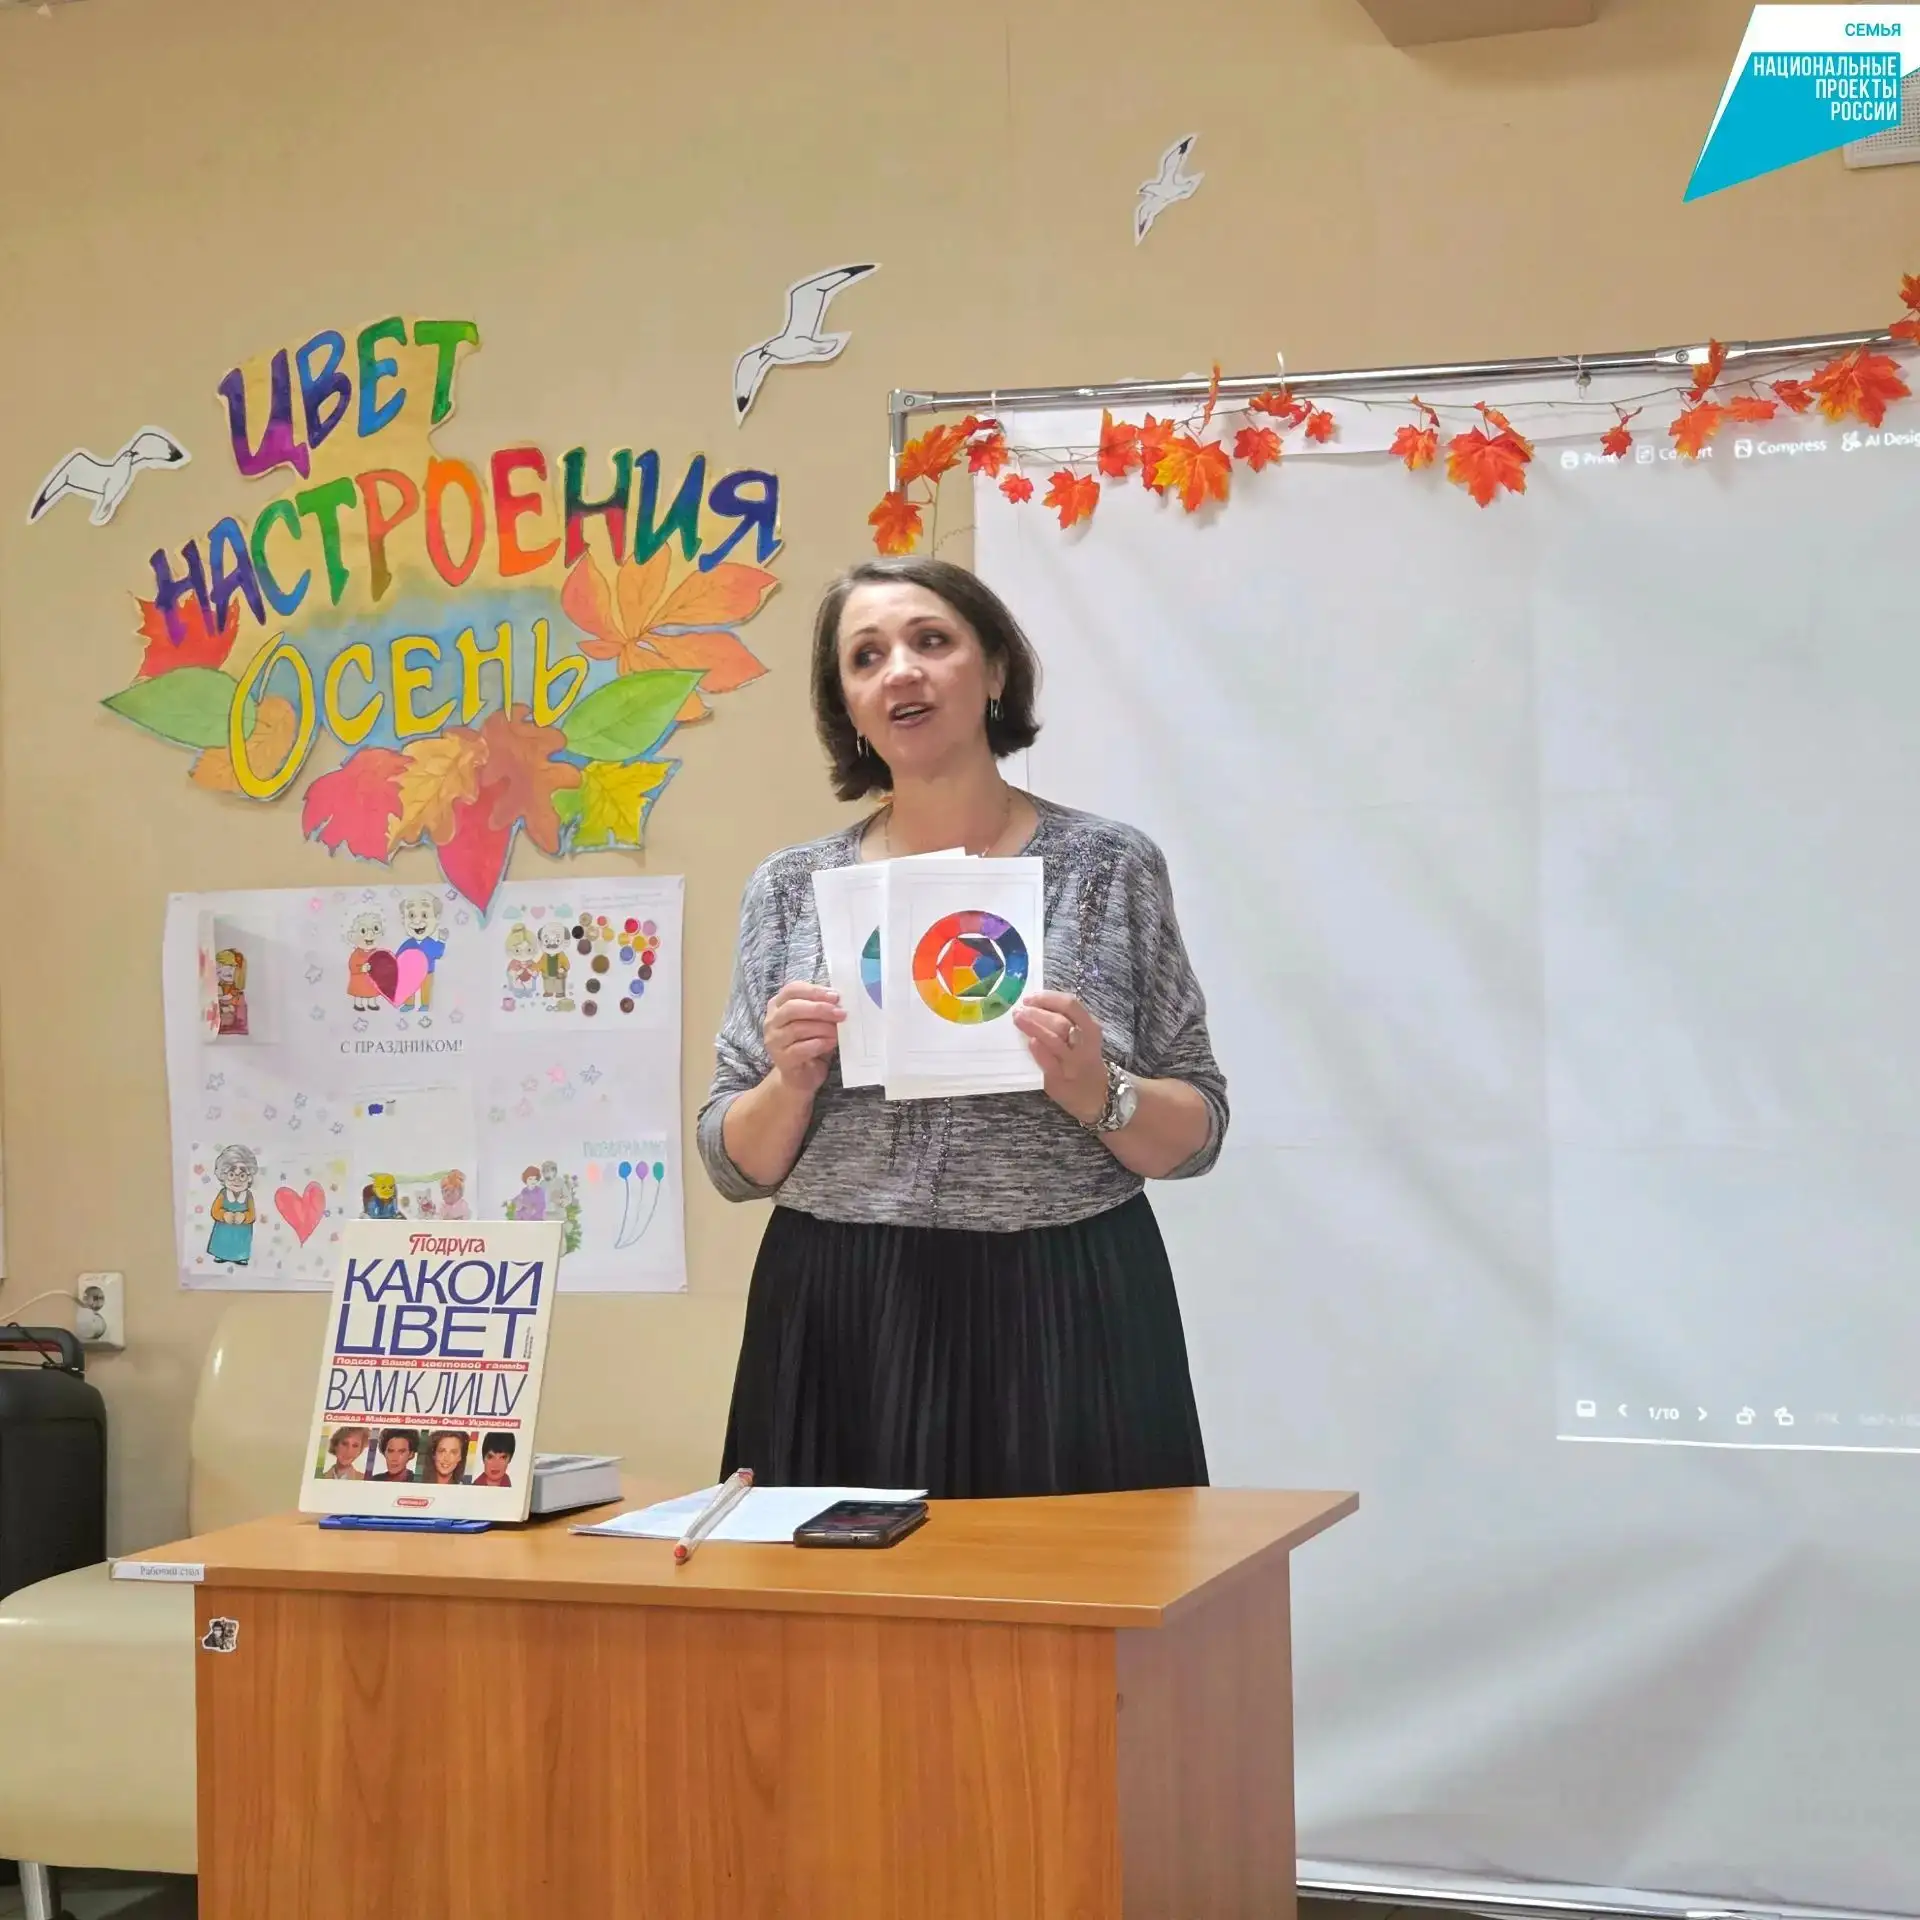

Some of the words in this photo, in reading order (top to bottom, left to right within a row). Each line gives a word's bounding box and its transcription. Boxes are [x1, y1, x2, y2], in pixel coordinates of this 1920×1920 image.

[218, 316, 480, 479] ЦВЕТ
[1757, 440, 1828, 456] Compress
[148, 446, 783, 648] НАСТРОЕНИЯ
[340, 1040, 351, 1053] С
[355, 1039, 463, 1055] ПРАЗДНИКОМ!
[409, 1233, 485, 1256] Подруга
[342, 1258, 544, 1306] КАКОЙ
[334, 1304, 537, 1359] ЦВЕТ
[336, 1356, 378, 1367] Подбор
[380, 1358, 418, 1368] Вашей
[325, 1367, 399, 1413] ВАМ
[401, 1370, 421, 1414] К
[425, 1372, 528, 1417] ЛИЦУ
[1648, 1406, 1680, 1420] 1/10
